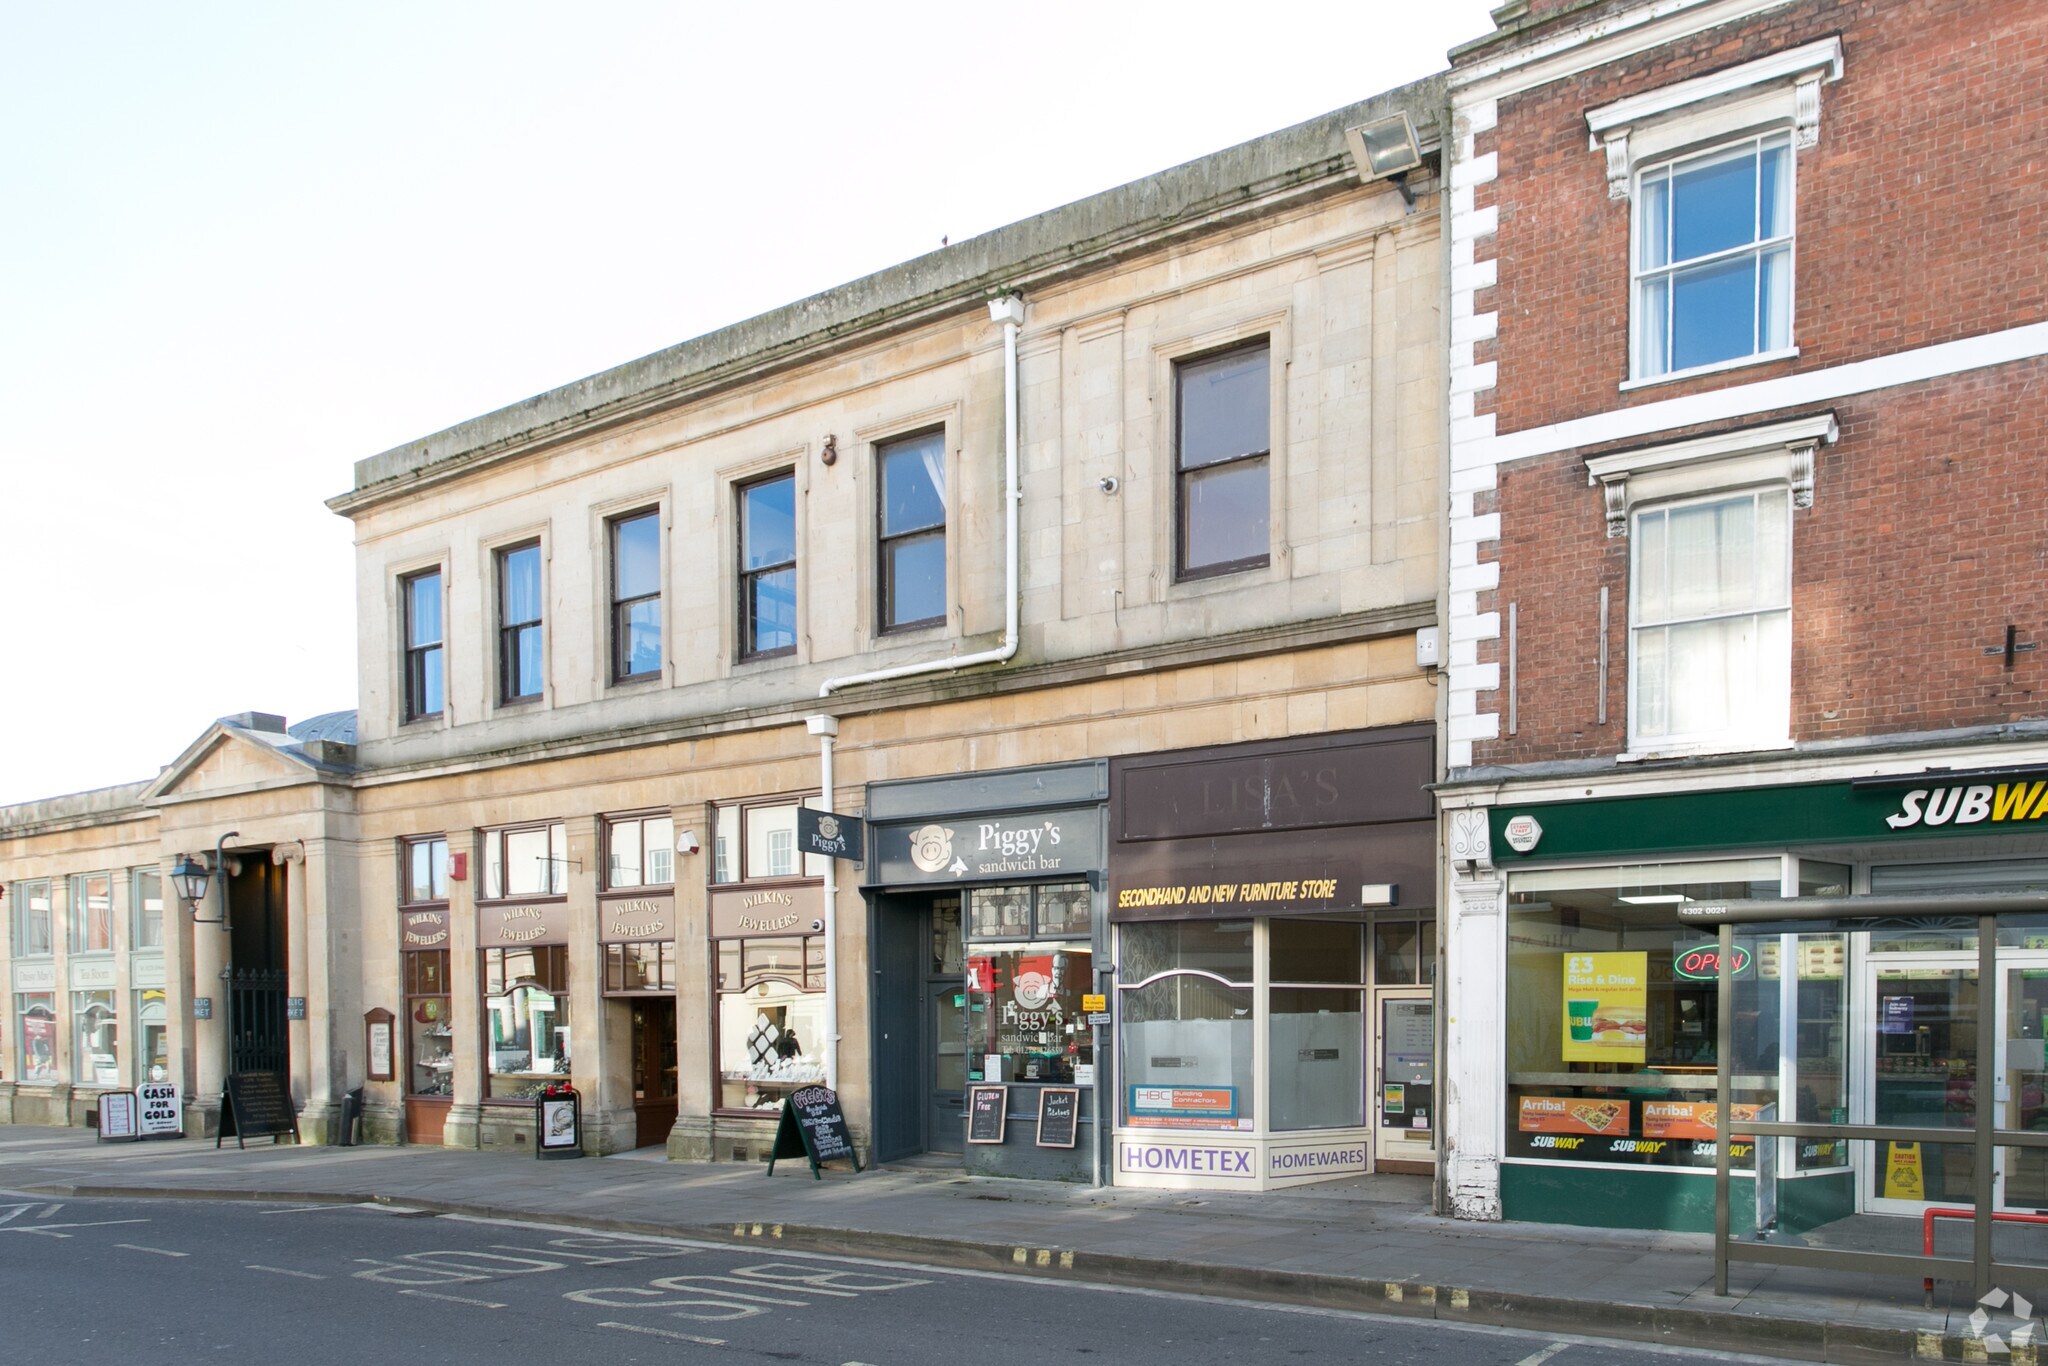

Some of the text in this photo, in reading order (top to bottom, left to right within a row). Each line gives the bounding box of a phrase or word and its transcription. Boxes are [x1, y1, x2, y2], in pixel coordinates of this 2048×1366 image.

[1200, 767, 1339, 815] LISA'S
[812, 834, 846, 853] Piggy's
[978, 821, 1060, 856] Piggy's
[979, 854, 1061, 873] sandwich bar
[743, 890, 793, 909] WILKINS
[1118, 879, 1337, 908] SECONDHAND AND NEW FURNITURE STORE
[503, 907, 542, 922] WILKINS
[616, 900, 659, 916] WILKINS
[1706, 906, 1726, 914] 0024
[408, 913, 444, 926] WILKINS
[738, 912, 799, 932] JEWELLERS
[500, 924, 547, 942] JEWELLERS
[612, 919, 664, 937] JEWELLERS
[404, 930, 448, 946] JEWELLERS
[1568, 956, 1594, 974] £3
[1568, 975, 1593, 984] Rise
[1608, 974, 1636, 984] Dine
[1001, 1031, 1044, 1042] sandwic
[144, 1088, 175, 1099] CASH
[1138, 1090, 1170, 1100] HBC
[1522, 1100, 1566, 1111] Arriba!
[1646, 1104, 1693, 1116] Arriba!
[144, 1110, 176, 1120] GOLD
[1530, 1136, 1584, 1150] SUBWAY
[1609, 1139, 1667, 1154] SUBWAY
[1694, 1143, 1753, 1157] SUAY
[1802, 1143, 1835, 1158] SUBWAY
[1127, 1147, 1363, 1172] HOMETEX HOMEWARES
[561, 1262, 936, 1322] BUS
